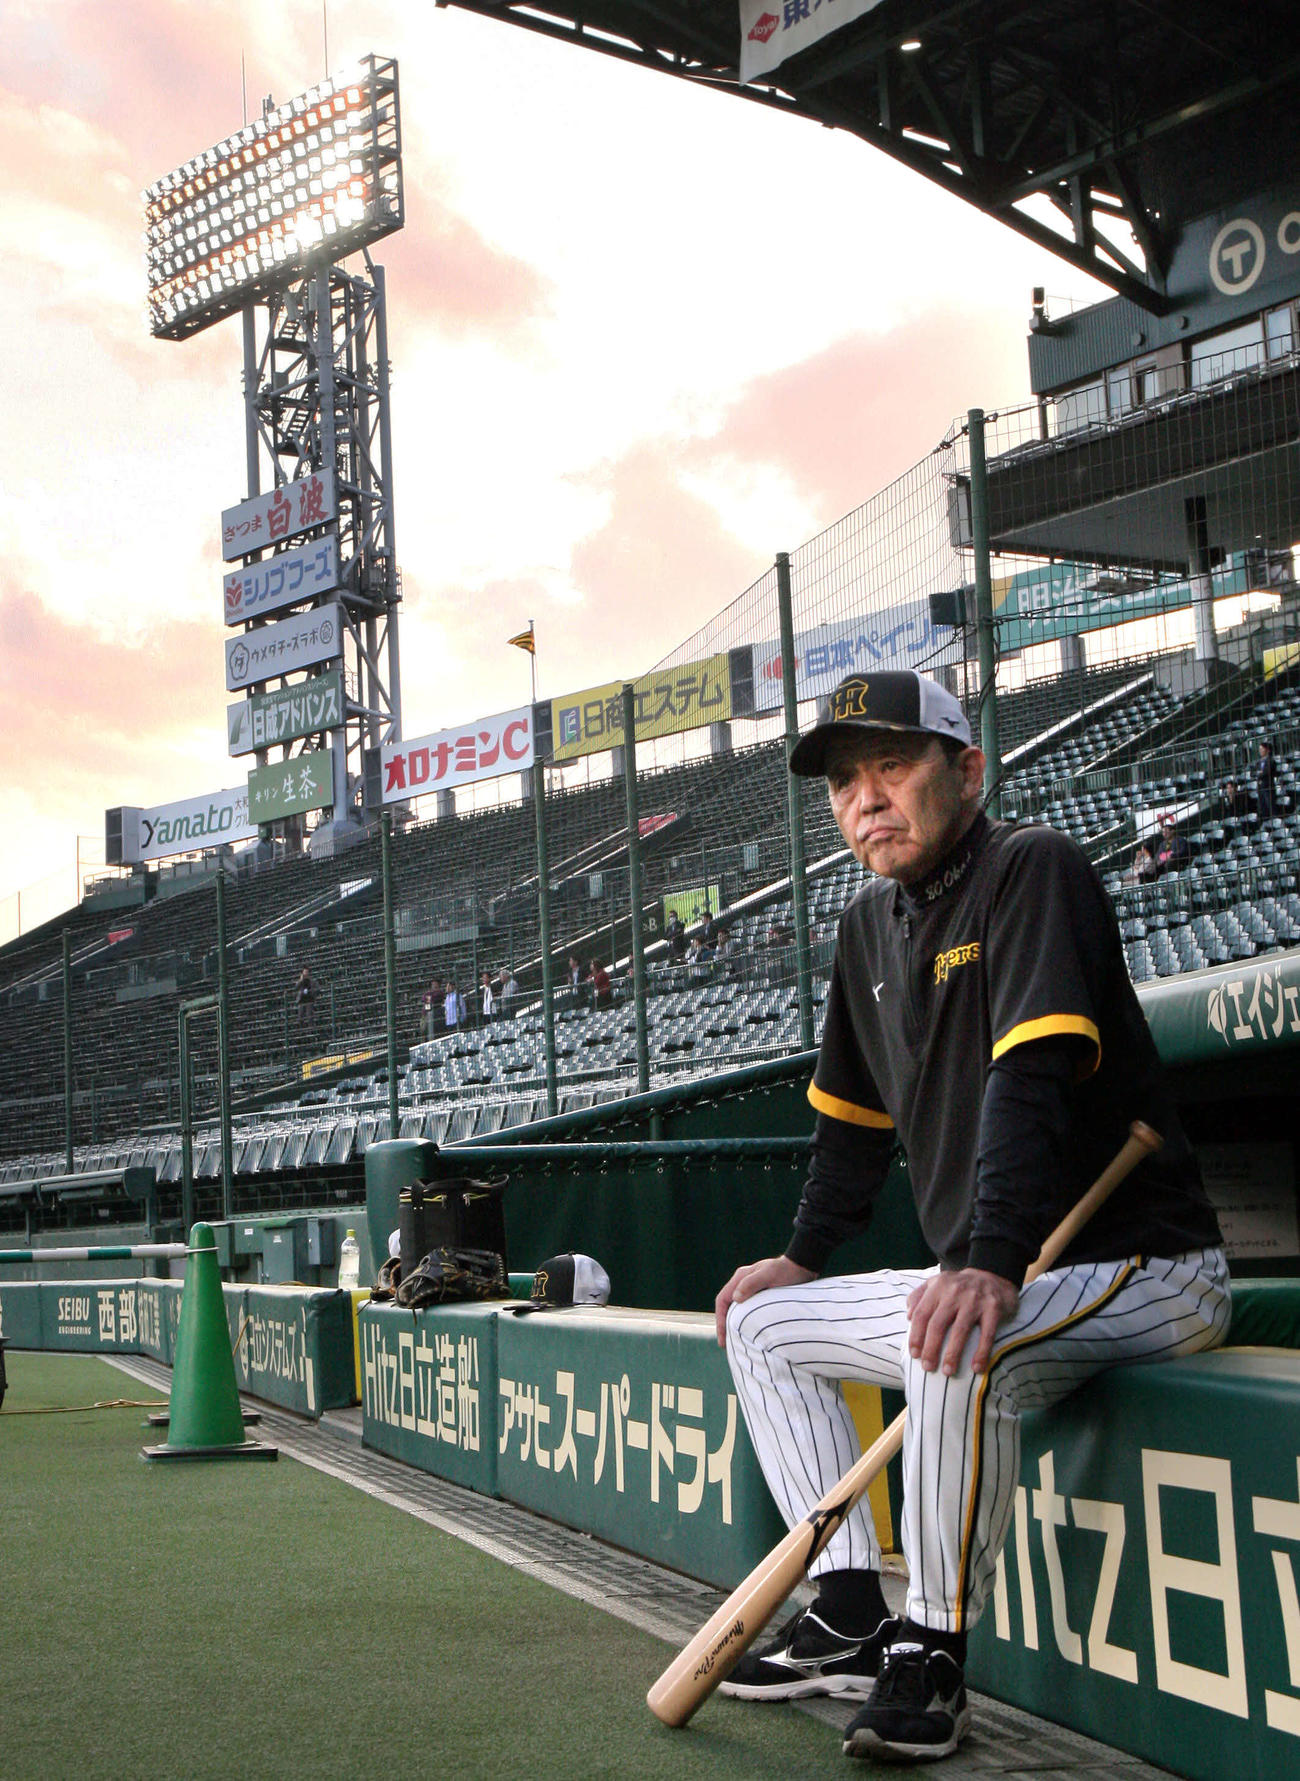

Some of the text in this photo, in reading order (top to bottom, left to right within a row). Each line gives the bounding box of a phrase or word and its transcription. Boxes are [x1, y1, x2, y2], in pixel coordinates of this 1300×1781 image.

[244, 544, 331, 606] シノブフーズ
[252, 627, 319, 662] ウメダチーズラボ
[253, 688, 338, 744] 日成アドバンス
[385, 718, 530, 793] オロナミンC
[141, 804, 233, 849] Yamato
[58, 1297, 90, 1321] SEIBU
[58, 1326, 92, 1335] ENGINEERING
